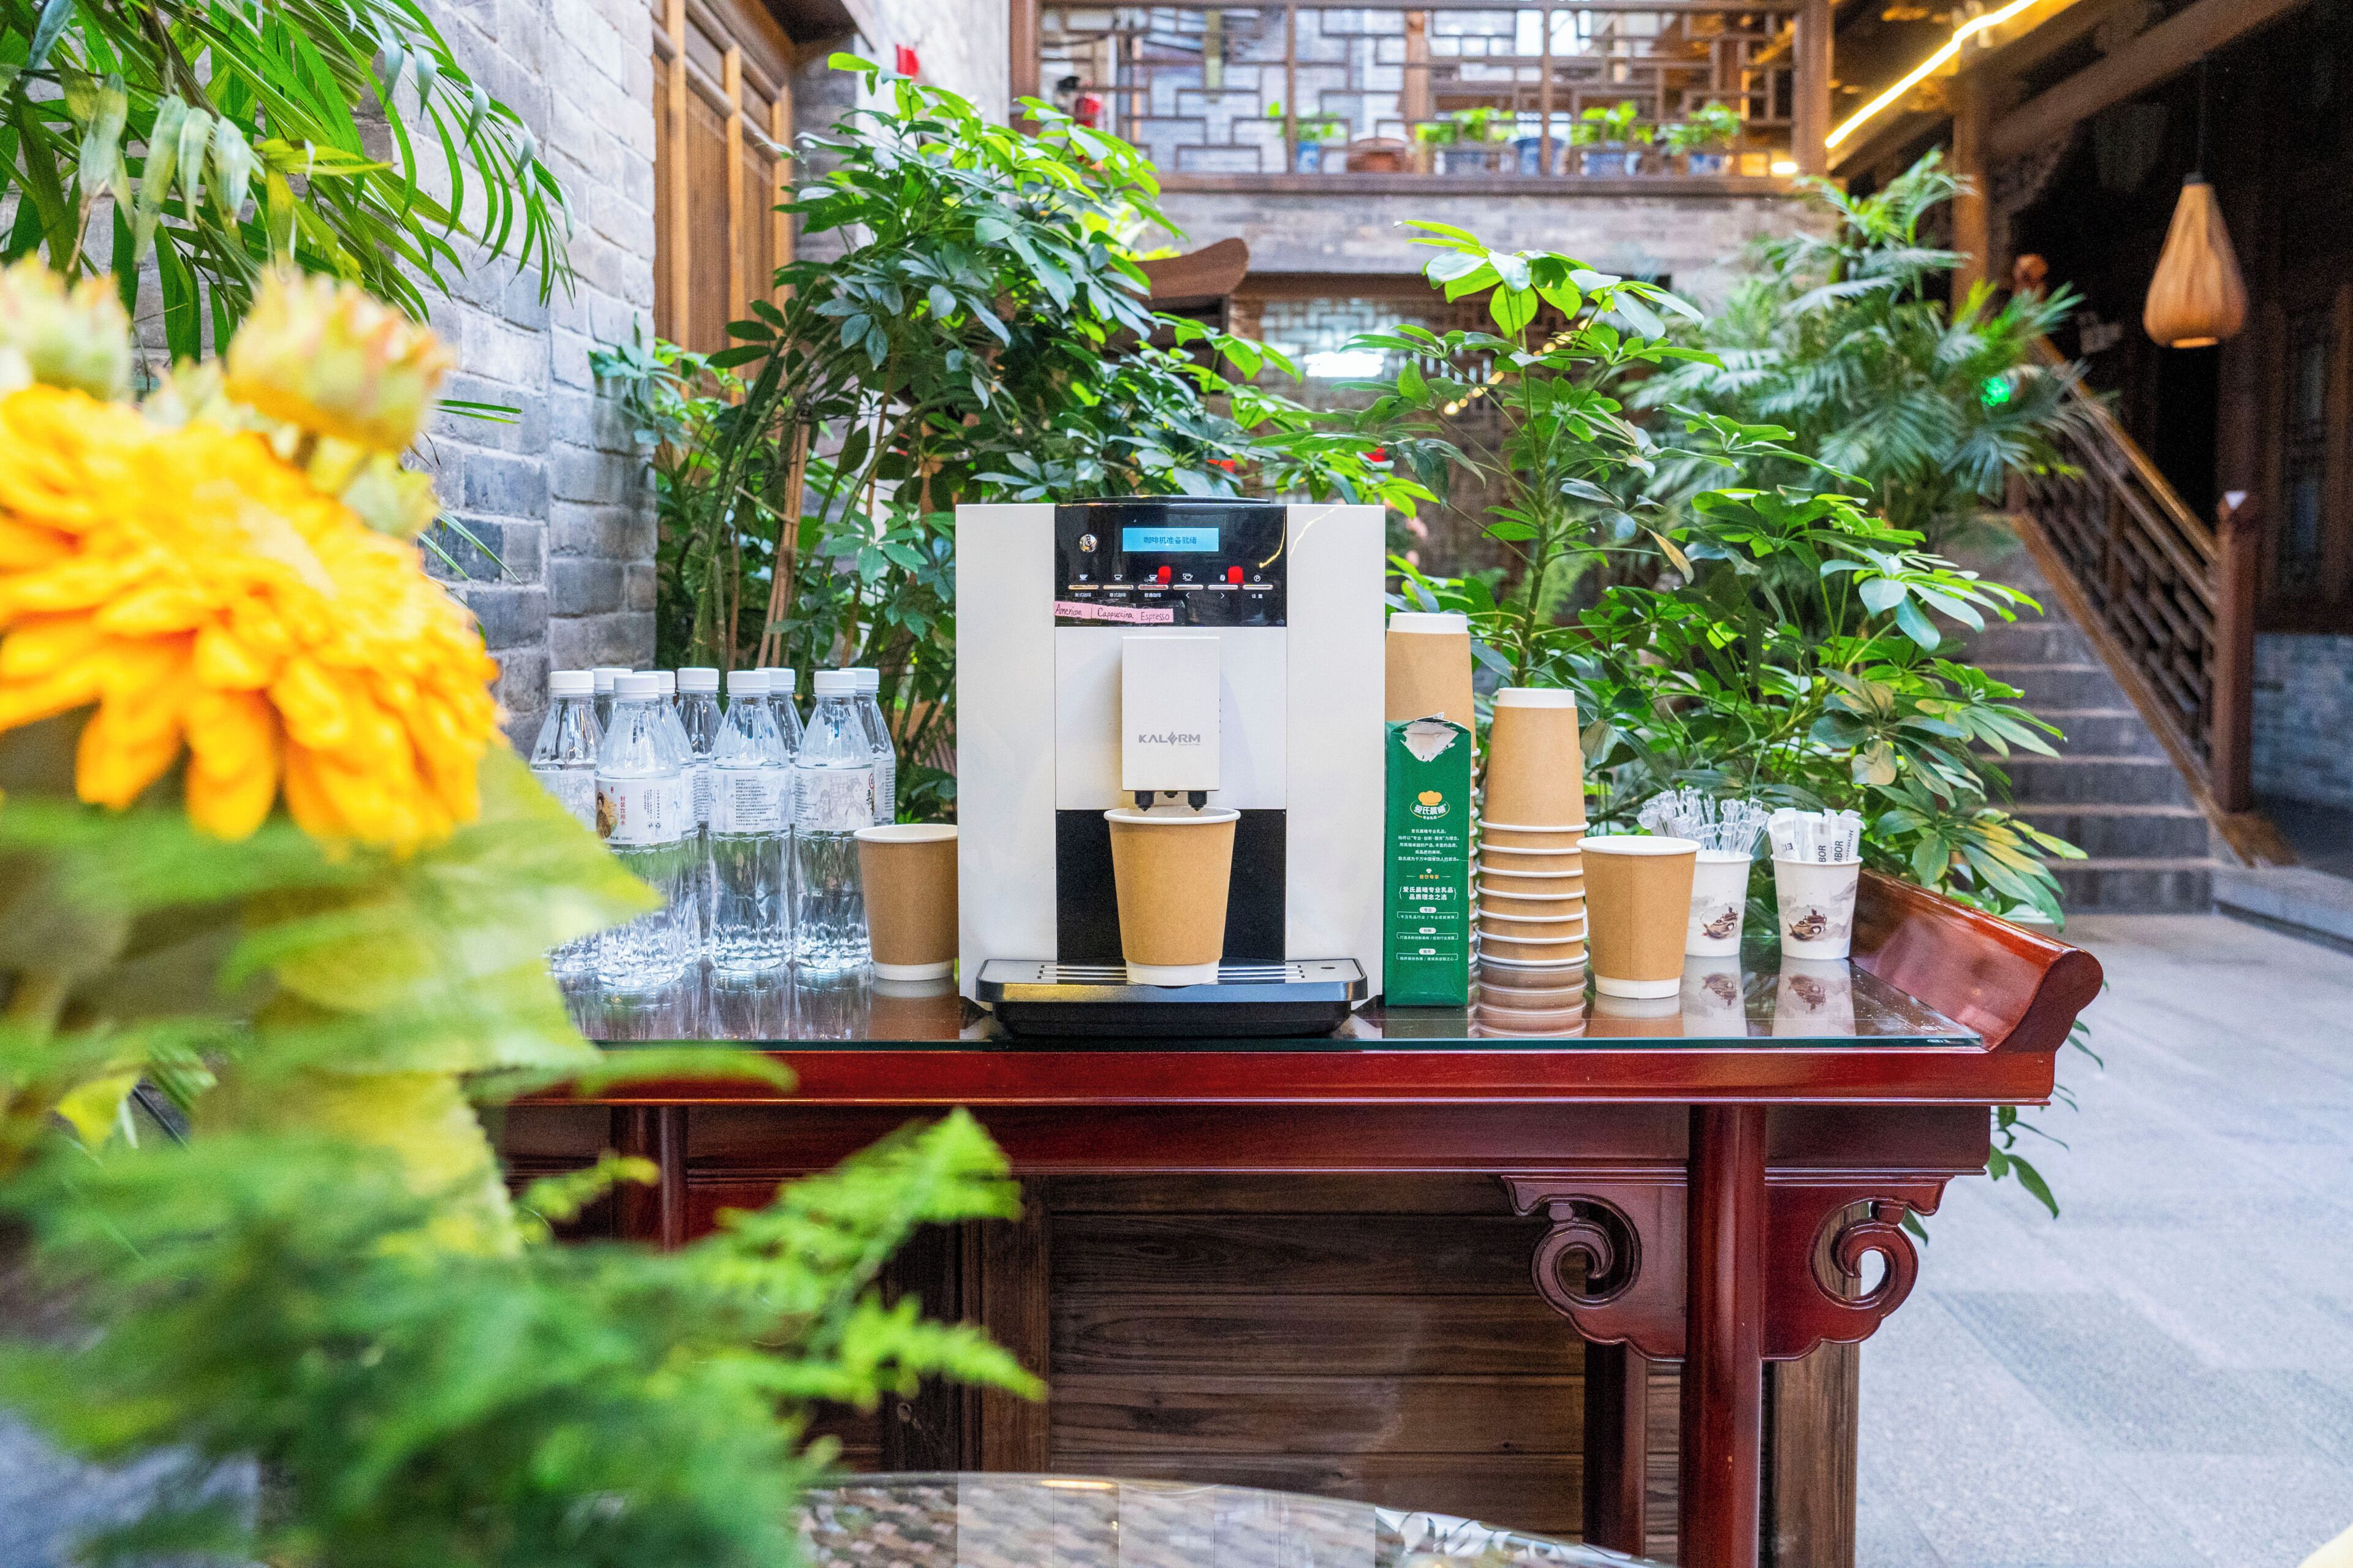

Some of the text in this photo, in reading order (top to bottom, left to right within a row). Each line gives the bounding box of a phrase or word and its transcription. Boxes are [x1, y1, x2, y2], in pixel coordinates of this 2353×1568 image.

[1056, 604, 1082, 616] American
[1140, 612, 1170, 623] Espresso
[1414, 805, 1446, 815] 爱氏晨曦
